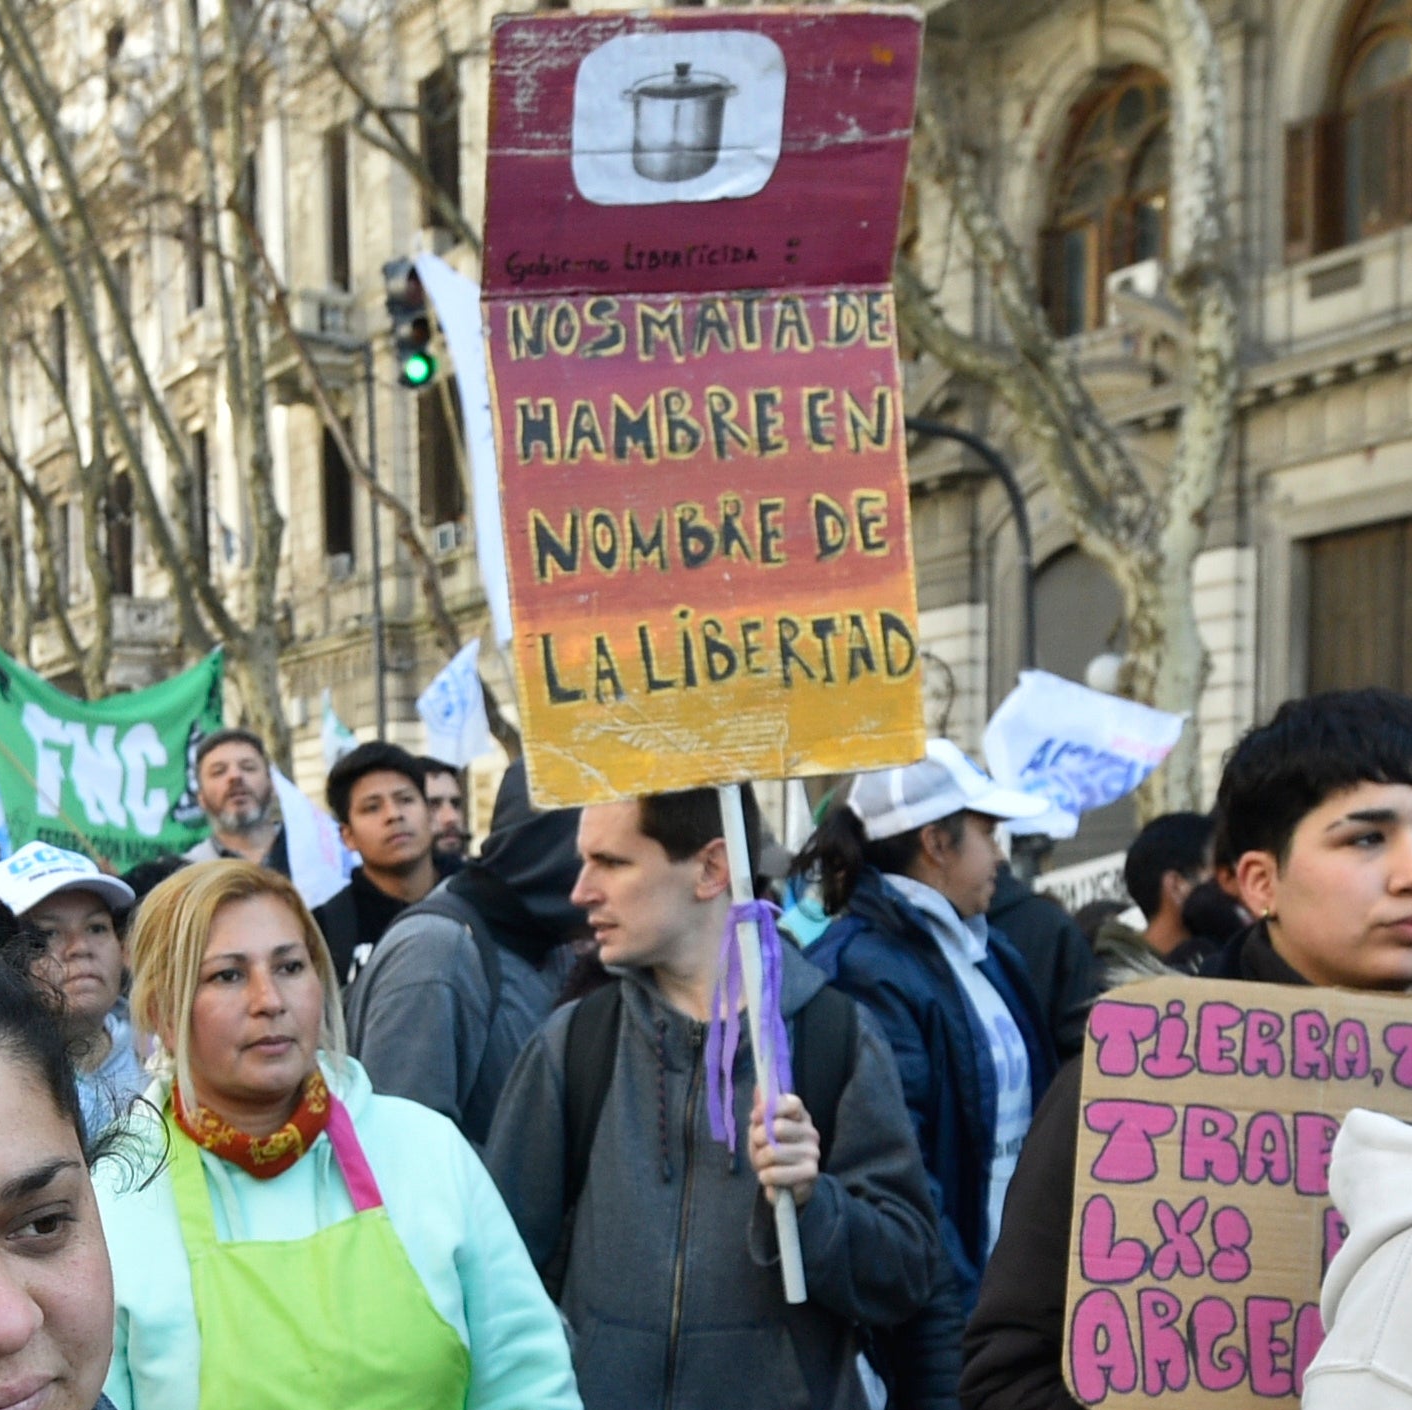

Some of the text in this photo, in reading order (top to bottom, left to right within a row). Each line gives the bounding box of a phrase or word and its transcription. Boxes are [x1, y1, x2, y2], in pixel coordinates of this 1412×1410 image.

[825, 290, 892, 348] DE
[518, 386, 893, 465] HAMBRE EN
[529, 490, 890, 582] NOMBRE DE
[540, 630, 625, 708] LA
[21, 702, 169, 837] FNC
